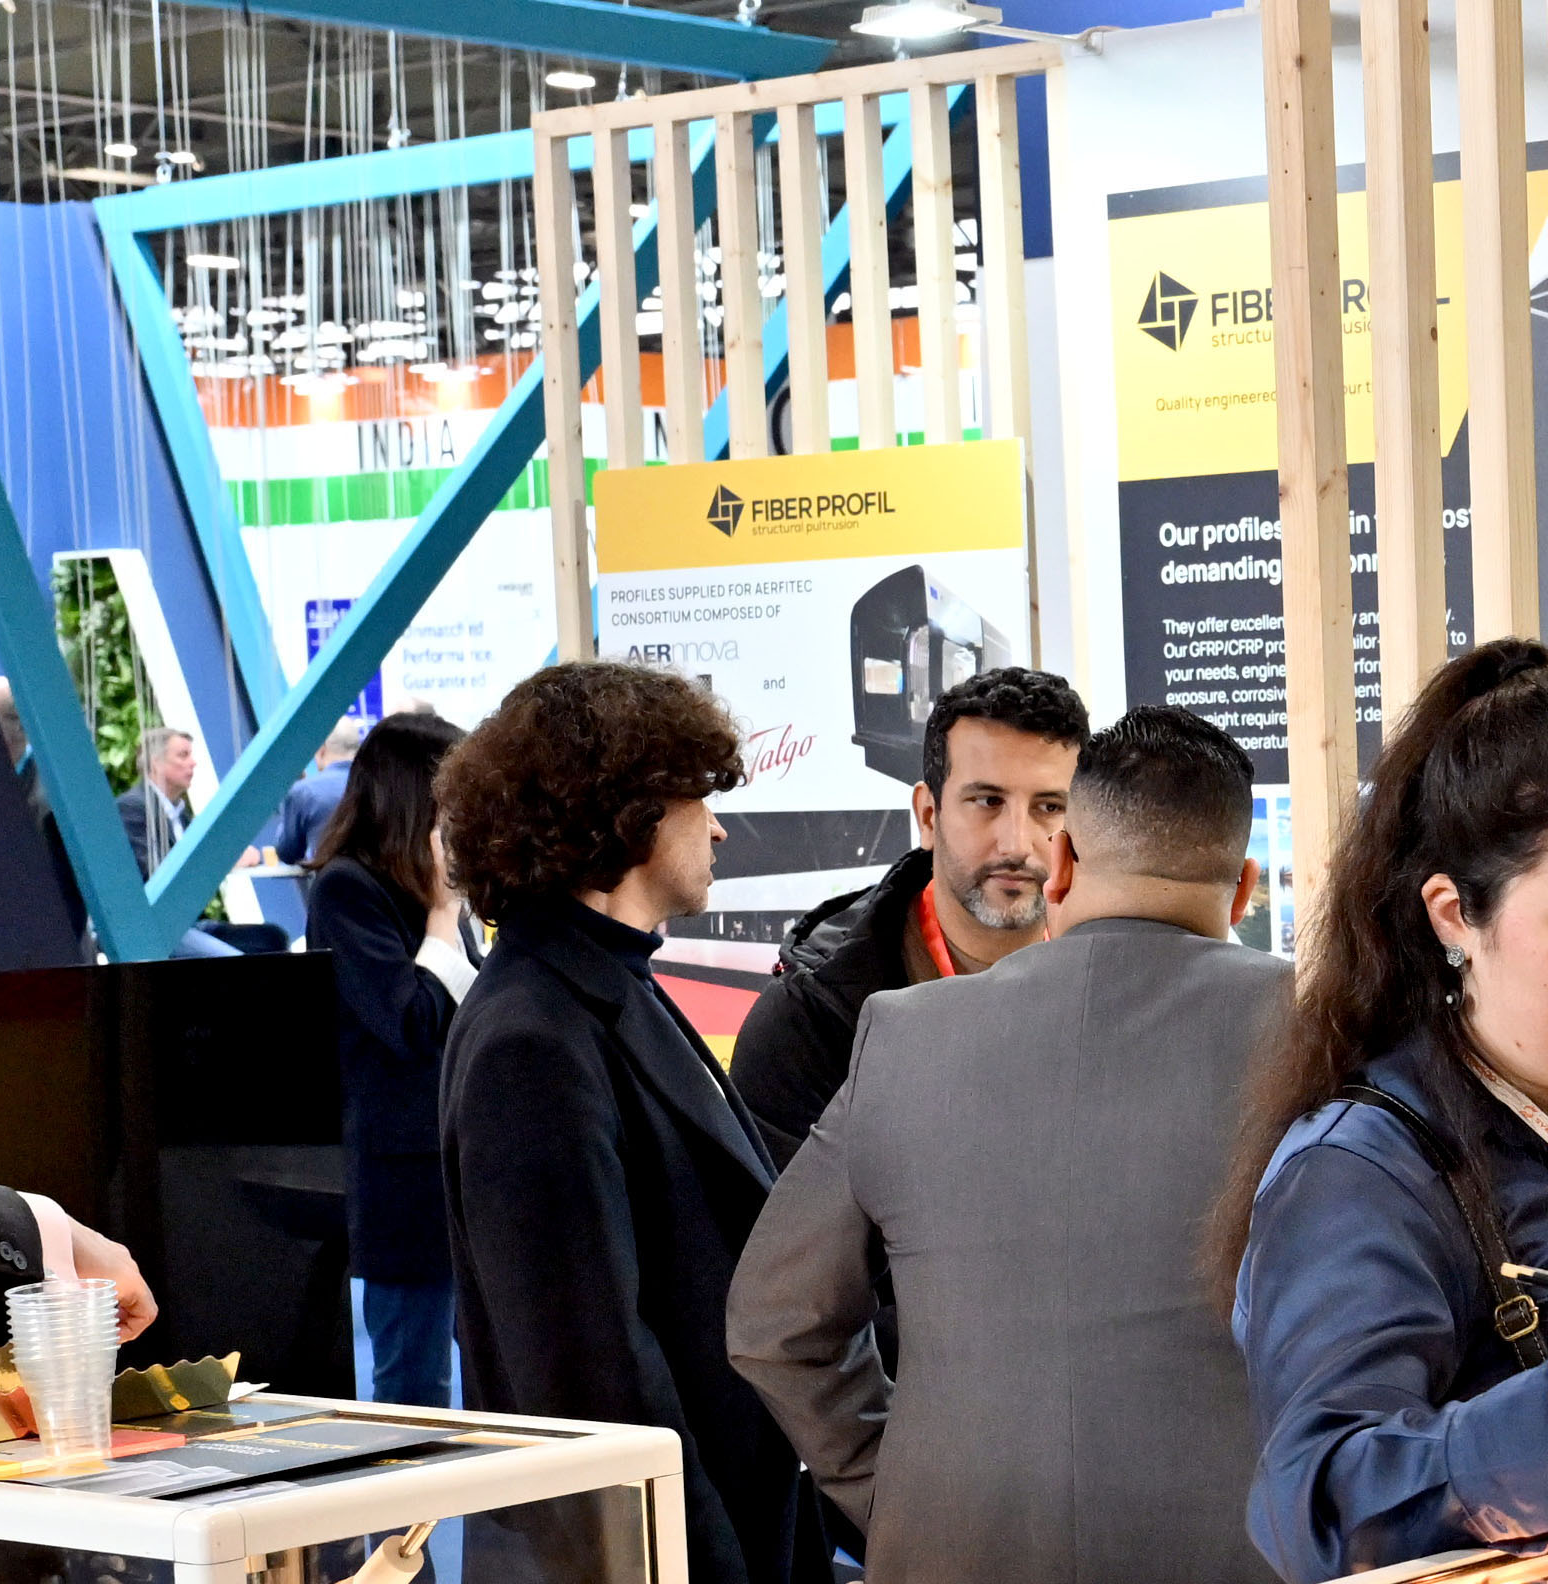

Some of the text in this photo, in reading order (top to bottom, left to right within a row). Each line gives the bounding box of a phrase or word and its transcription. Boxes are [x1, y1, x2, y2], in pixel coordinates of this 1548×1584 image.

[358, 420, 457, 470] INDIA
[751, 491, 896, 522] FIBER PROFIL
[751, 520, 860, 536] structural pultrusion
[1159, 522, 1199, 548] Our
[1161, 555, 1282, 585] demanding
[610, 579, 813, 605] PROFILES SUPPLIED FOR AERFITEC
[611, 604, 781, 627] CONSORTIUM COMPOSED OF
[1163, 617, 1229, 638] They offer
[1164, 639, 1264, 658] Our GFRP/CFRP
[763, 676, 786, 691] and
[1165, 662, 1240, 685] your needs,
[1166, 686, 1229, 706] exposure,
